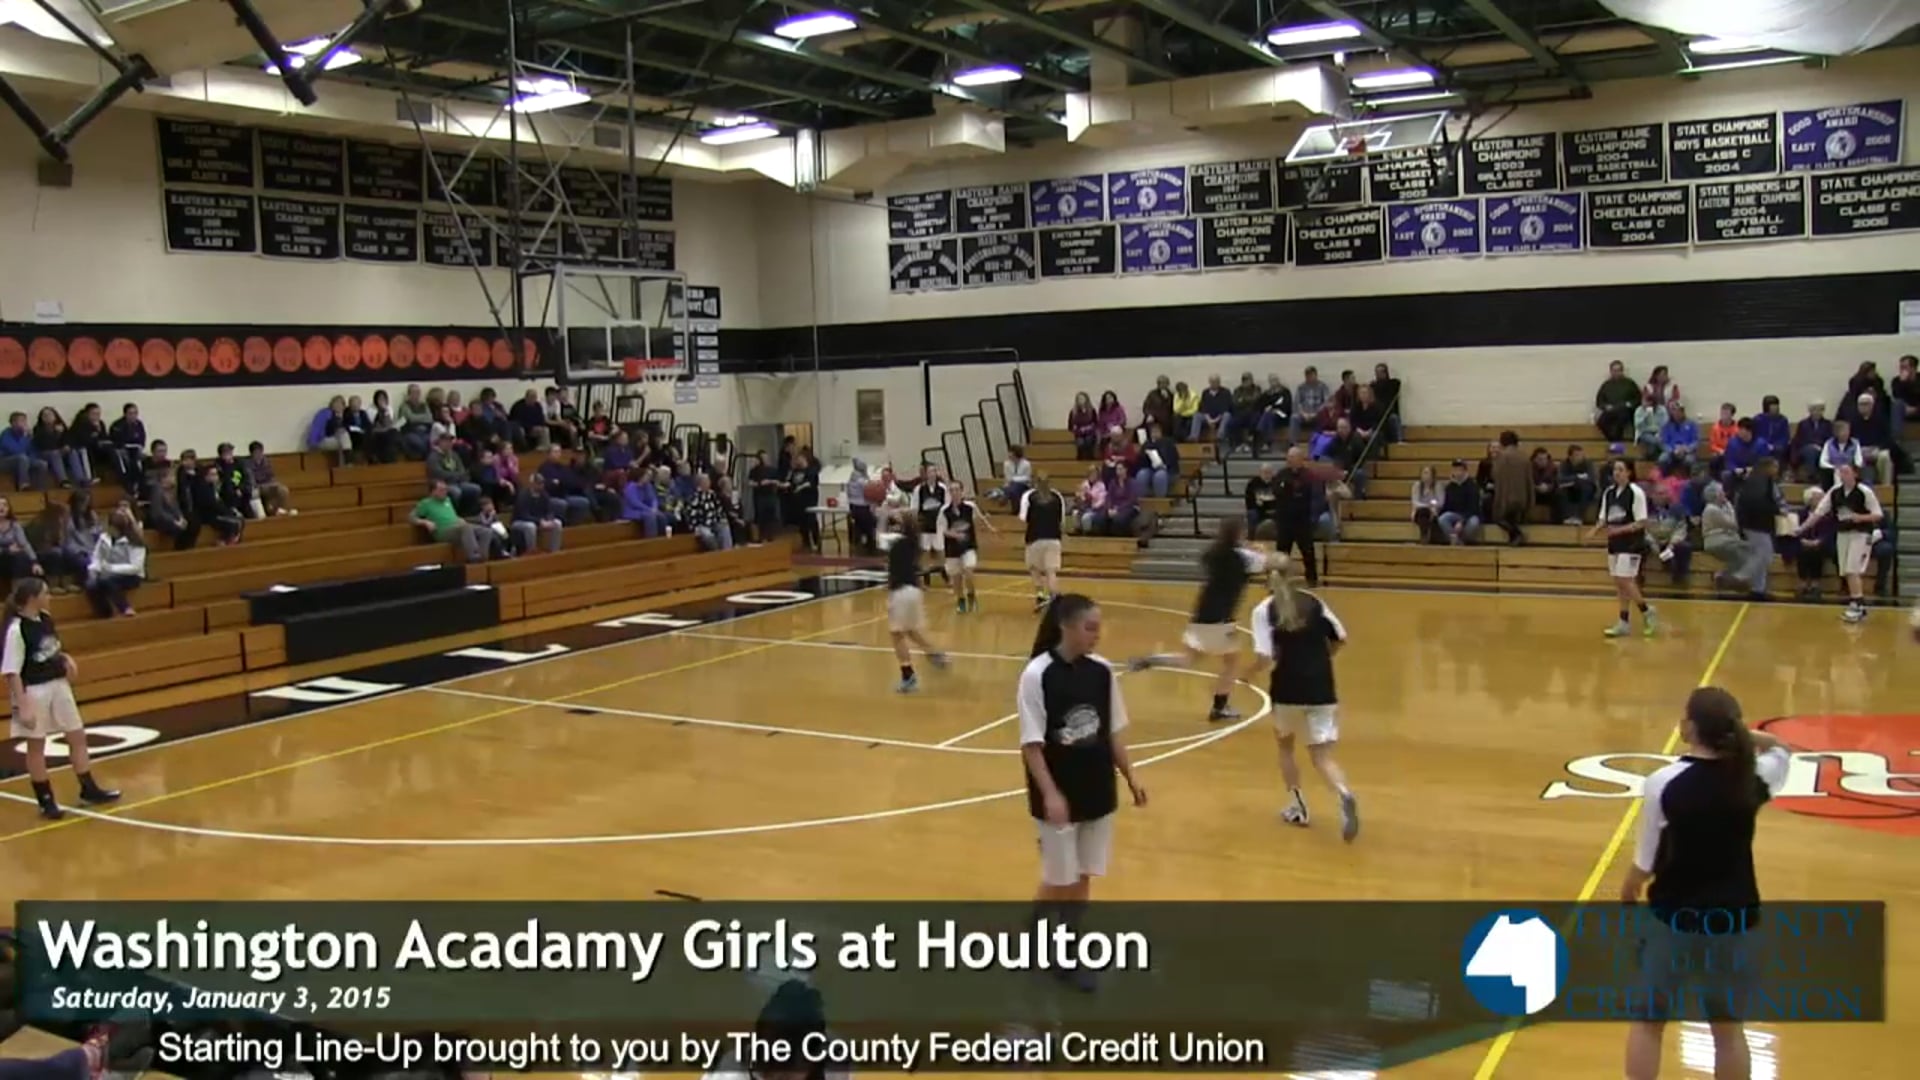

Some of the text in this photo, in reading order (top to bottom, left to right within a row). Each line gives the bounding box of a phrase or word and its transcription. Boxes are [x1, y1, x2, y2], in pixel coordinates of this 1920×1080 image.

[1676, 117, 1770, 137] STATE CHAMPIONS
[1574, 129, 1618, 143] EASTERN
[1673, 131, 1773, 151] BOYS BASKETBALL
[1472, 139, 1514, 152] EASTERN
[1578, 138, 1648, 154] CHAMPIONS
[1791, 142, 1817, 153] EAST
[1478, 149, 1541, 162] CHAMPIONS
[1596, 152, 1630, 162] 2004
[1694, 148, 1752, 163] CLASS C
[1703, 162, 1741, 174] 2004
[1587, 171, 1629, 183] CLASS
[1820, 170, 1920, 190] STATE CHAMPIONS
[1486, 181, 1523, 190] CLASS
[1700, 184, 1730, 198] STATE
[1594, 189, 1683, 206] STATE CHAMPIONS
[1592, 203, 1687, 219] CHEERLEADING
[1731, 206, 1767, 217] 2004
[1840, 202, 1901, 216] CLASS C
[1611, 218, 1666, 231] CLASS C
[1715, 214, 1785, 229] SOFTBALL
[1621, 231, 1656, 242] 2004
[1721, 226, 1765, 239] CLASS
